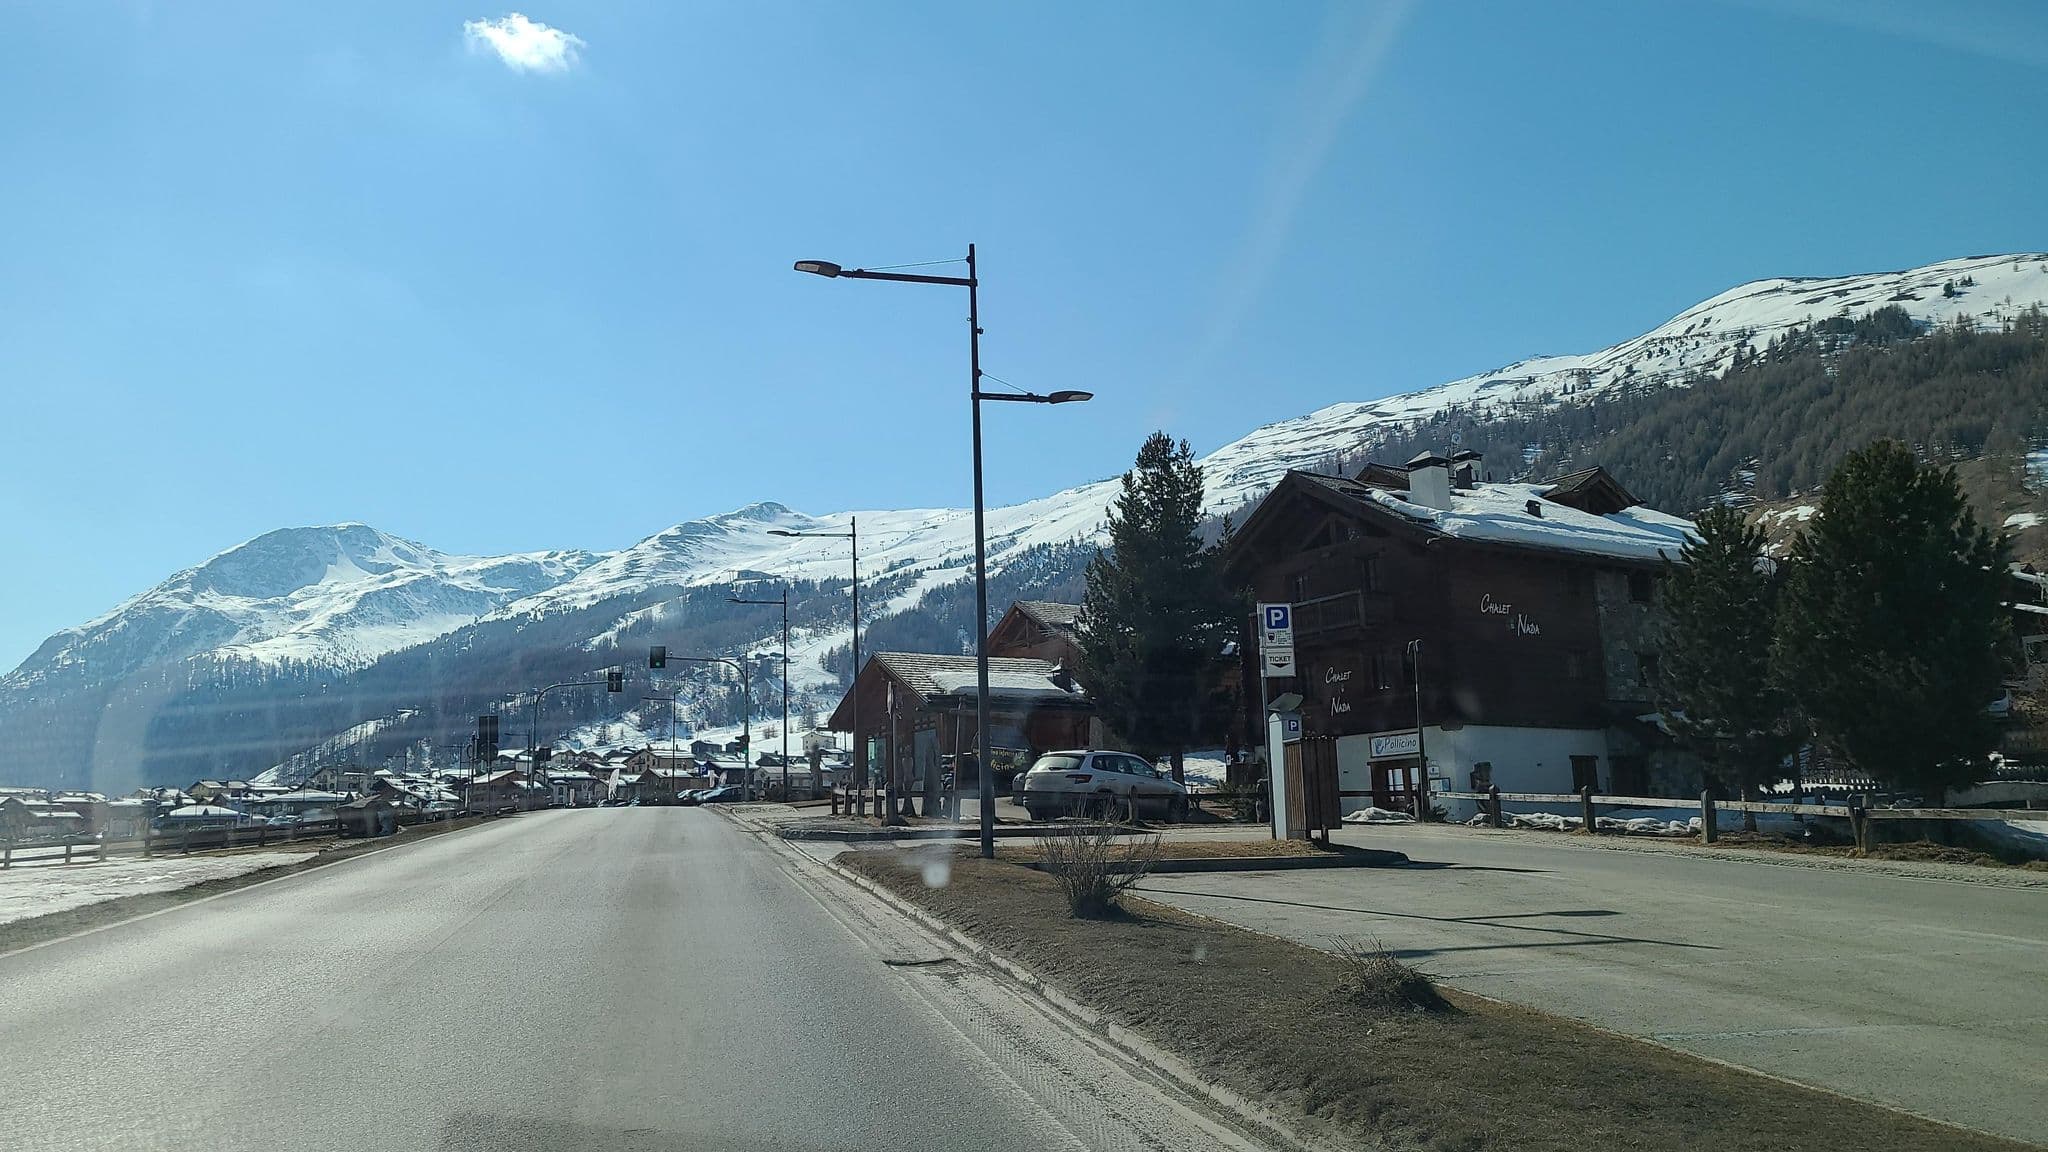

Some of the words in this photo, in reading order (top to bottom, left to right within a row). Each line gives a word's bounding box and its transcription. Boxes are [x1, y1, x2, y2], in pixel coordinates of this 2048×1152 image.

[1270, 609, 1284, 627] P
[1268, 655, 1291, 663] TICKET
[1290, 720, 1298, 731] P
[1384, 738, 1417, 751] Pollicino
